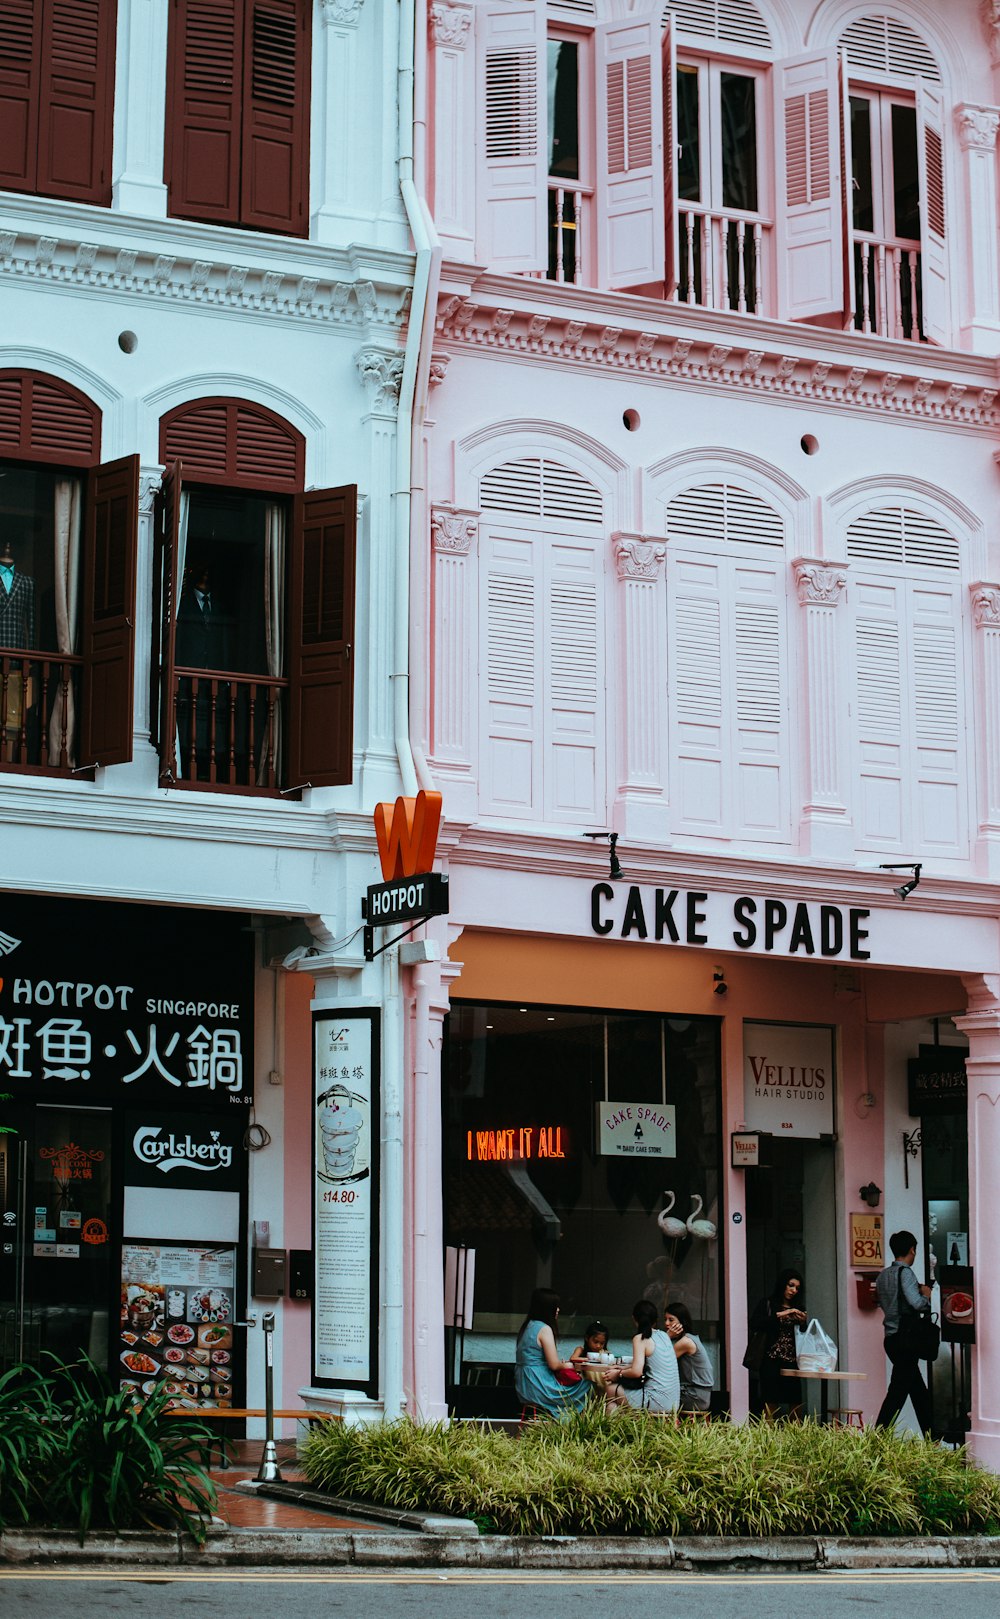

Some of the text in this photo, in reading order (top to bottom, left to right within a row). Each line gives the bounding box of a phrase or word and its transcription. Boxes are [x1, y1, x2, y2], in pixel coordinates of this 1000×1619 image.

[372, 883, 424, 915] HOTPOT
[591, 883, 870, 959] CAKE SPADE
[13, 979, 134, 1010] HOTPOT
[146, 999, 239, 1019] SINGAPORE
[229, 1095, 253, 1104] No. 81
[755, 1088, 825, 1100] HAIR STUDIO
[605, 1107, 672, 1132] CAKE SPADE
[133, 1126, 232, 1172] Carlsberg
[467, 1127, 565, 1161] I WANT IT ALL
[854, 1240, 882, 1259] 83A
[295, 1289, 307, 1297] 83
